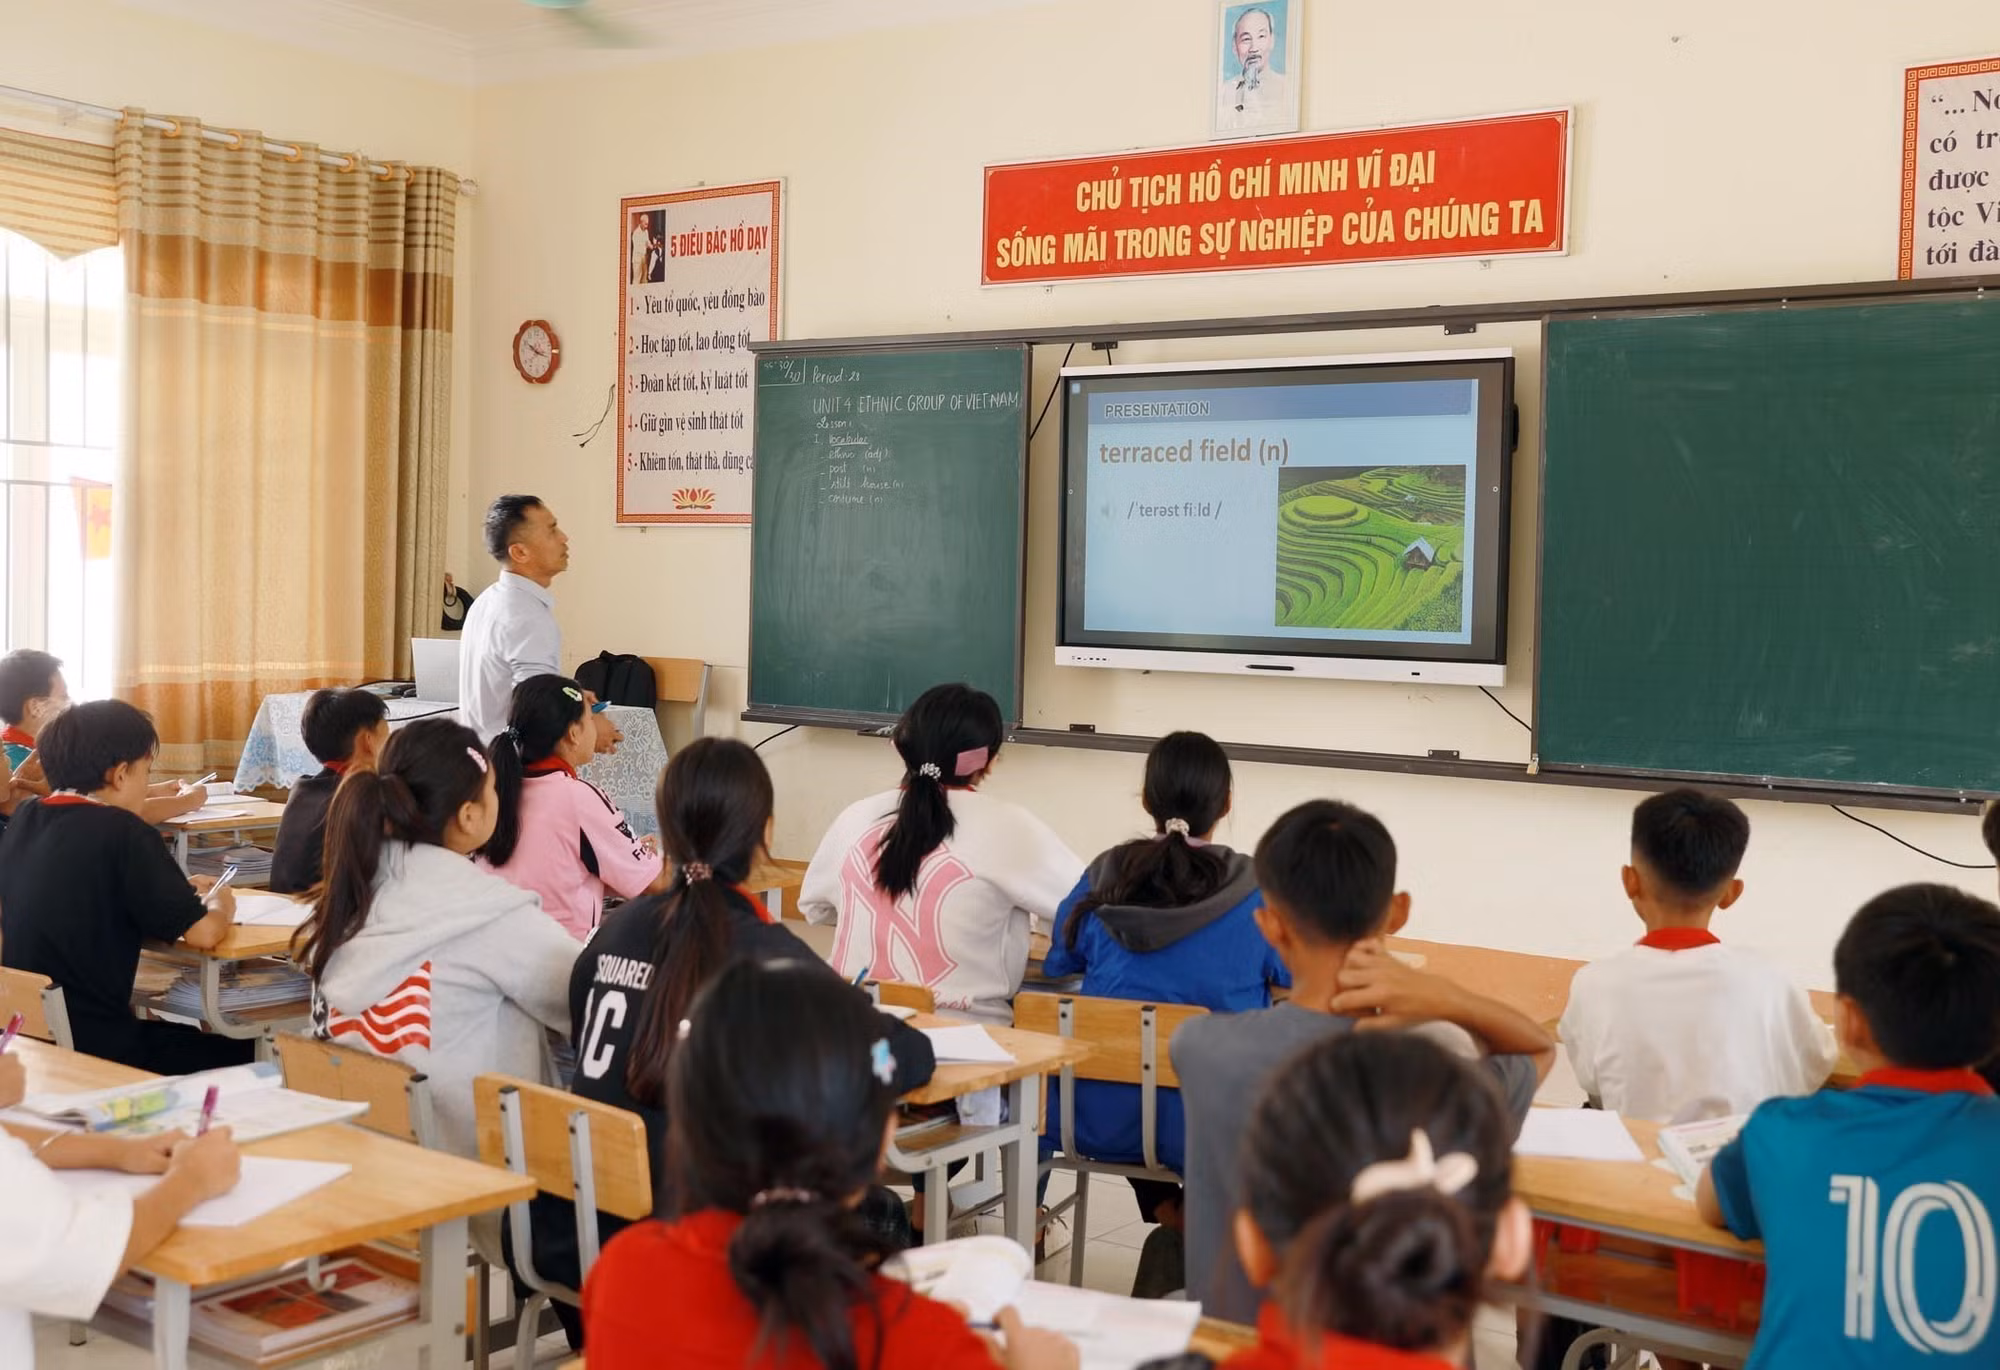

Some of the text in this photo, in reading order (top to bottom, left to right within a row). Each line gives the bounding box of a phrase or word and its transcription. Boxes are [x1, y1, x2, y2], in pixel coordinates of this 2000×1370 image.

[1929, 130, 2000, 153] có tr
[1076, 148, 1435, 215] CHỦ TỊCH HỒ CHÍ MINH VĨ ĐẠI
[1929, 169, 1989, 193] được
[996, 196, 1544, 269] SỐNG MÃI TRONG SỰ NGHIỆP CỦA CHÚNG TA
[1928, 206, 1964, 232] tộc
[671, 220, 768, 257] 5 ĐIỀU BÁC HỒ DẠY
[1926, 241, 1957, 265] tới
[645, 294, 662, 315] Yêu
[665, 290, 674, 313] tổ
[703, 291, 719, 316] yêu
[721, 287, 745, 312] đồng
[748, 287, 765, 307] bào
[641, 334, 658, 358] Học
[661, 334, 676, 357] tập
[696, 331, 710, 351] lao
[712, 329, 735, 354] động
[641, 373, 664, 393] Đoàn
[667, 369, 681, 392] kết
[715, 370, 732, 395] luật
[735, 368, 748, 389] tốt
[813, 396, 842, 414] UNIT
[859, 394, 903, 413] ETHNIC
[907, 394, 946, 411] GROUP
[1104, 401, 1211, 418] PRESENTATION
[640, 412, 657, 432] Giữ
[658, 411, 673, 436] gìn
[676, 410, 686, 435] vệ
[688, 411, 707, 431] sinh
[709, 411, 728, 434] thật
[731, 408, 743, 429] tốt
[640, 452, 666, 471] Khiêm
[686, 451, 702, 475] thật
[723, 451, 744, 475] dũng
[1100, 438, 1289, 465] terraced field (n)
[1829, 1173, 1998, 1355] 10
